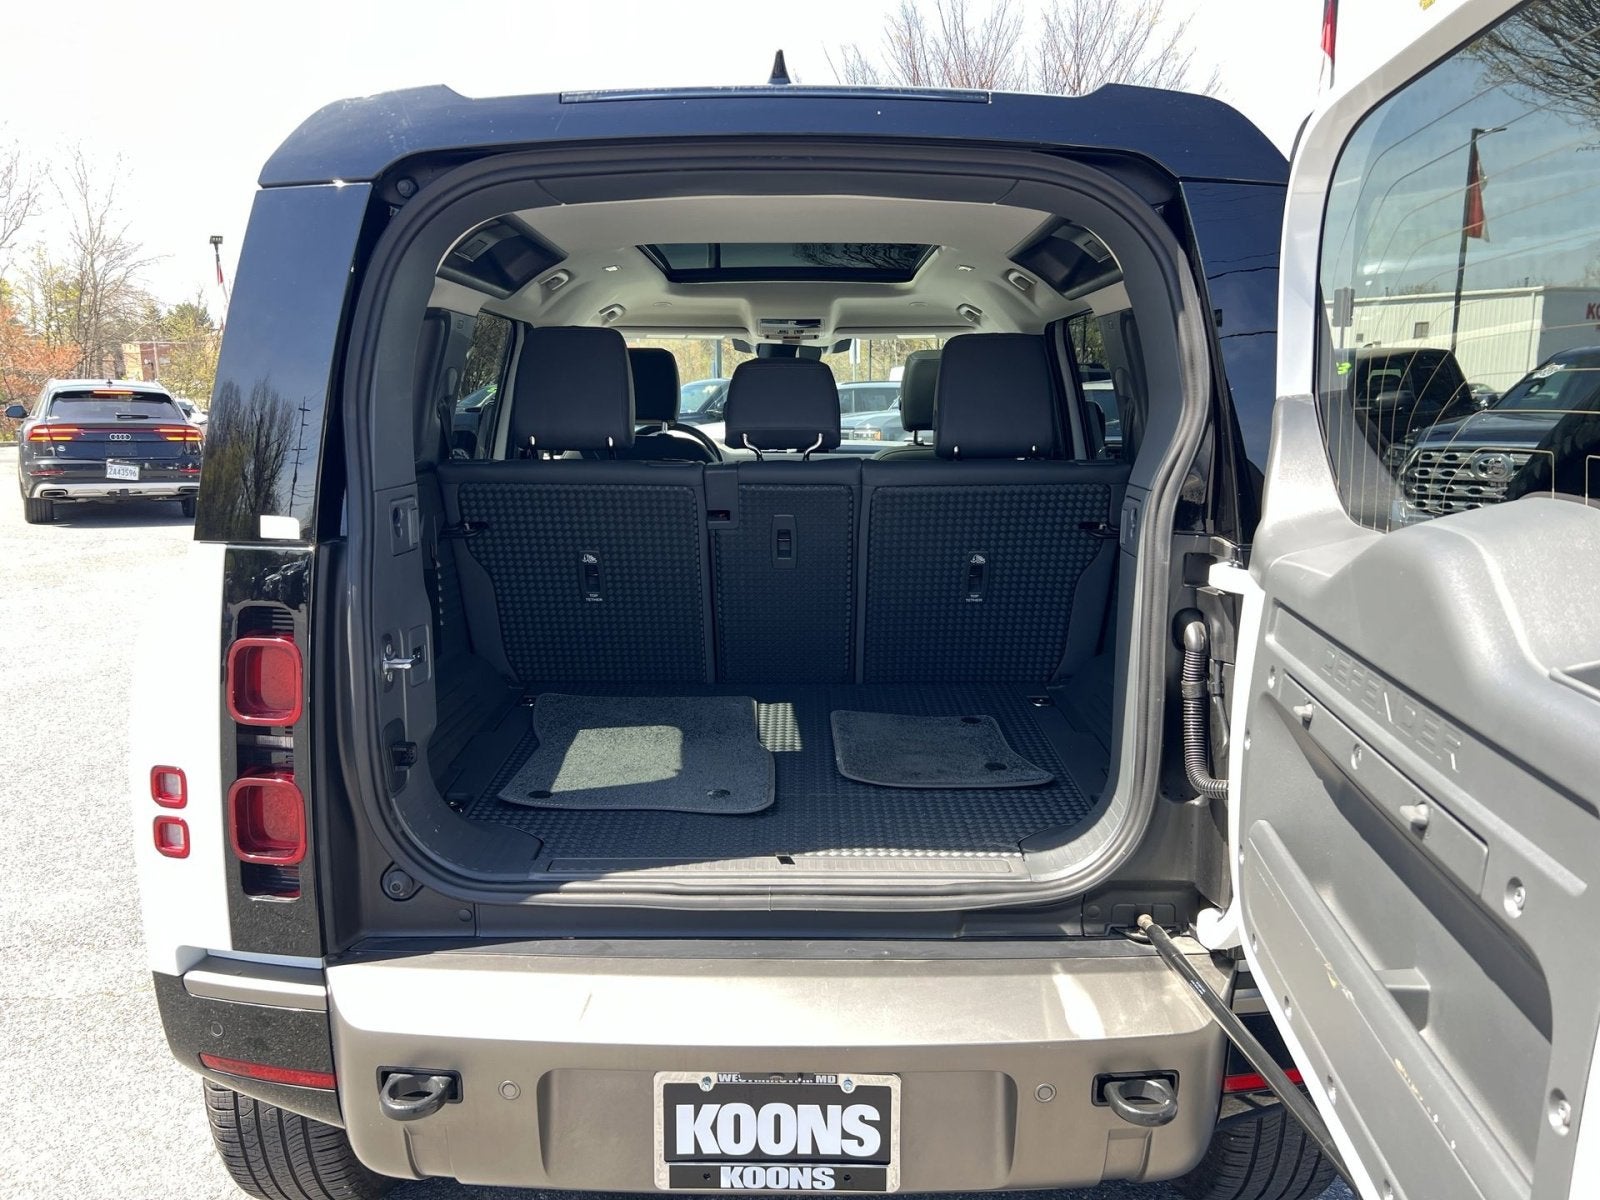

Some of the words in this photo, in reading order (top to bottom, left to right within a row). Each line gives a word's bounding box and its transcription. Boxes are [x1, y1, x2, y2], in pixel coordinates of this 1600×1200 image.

[815, 1075, 837, 1084] MD
[675, 1102, 881, 1157] KOONS
[720, 1166, 836, 1190] KOONS
